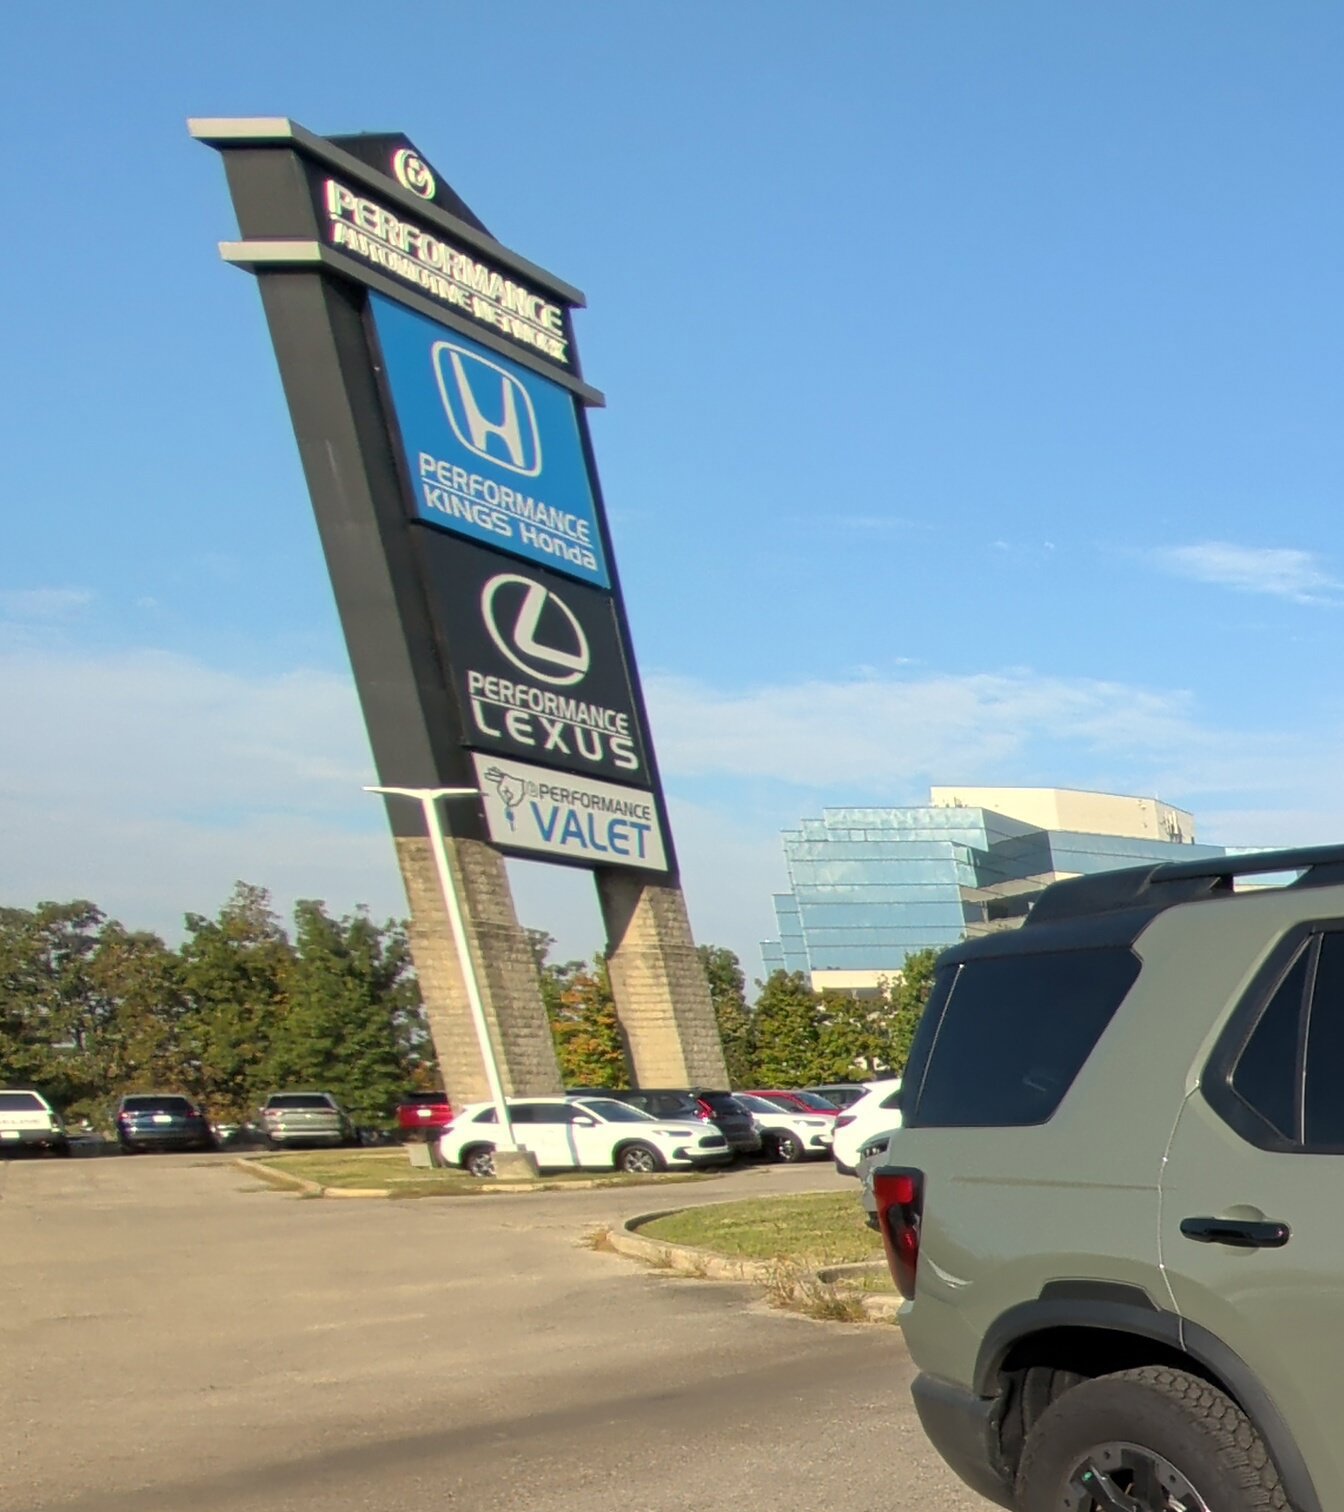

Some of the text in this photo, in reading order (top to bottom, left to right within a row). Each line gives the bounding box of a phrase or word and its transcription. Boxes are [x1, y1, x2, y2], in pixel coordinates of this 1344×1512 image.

[326, 179, 563, 337] PERFORMANCE
[418, 451, 591, 543] PERFORMANCE
[422, 483, 599, 572] KINGS Honda
[467, 669, 630, 735] PERFORMANCE
[472, 699, 639, 770] LEXUS
[529, 800, 652, 859] VALET
[538, 783, 652, 821] PERFORMANCE
